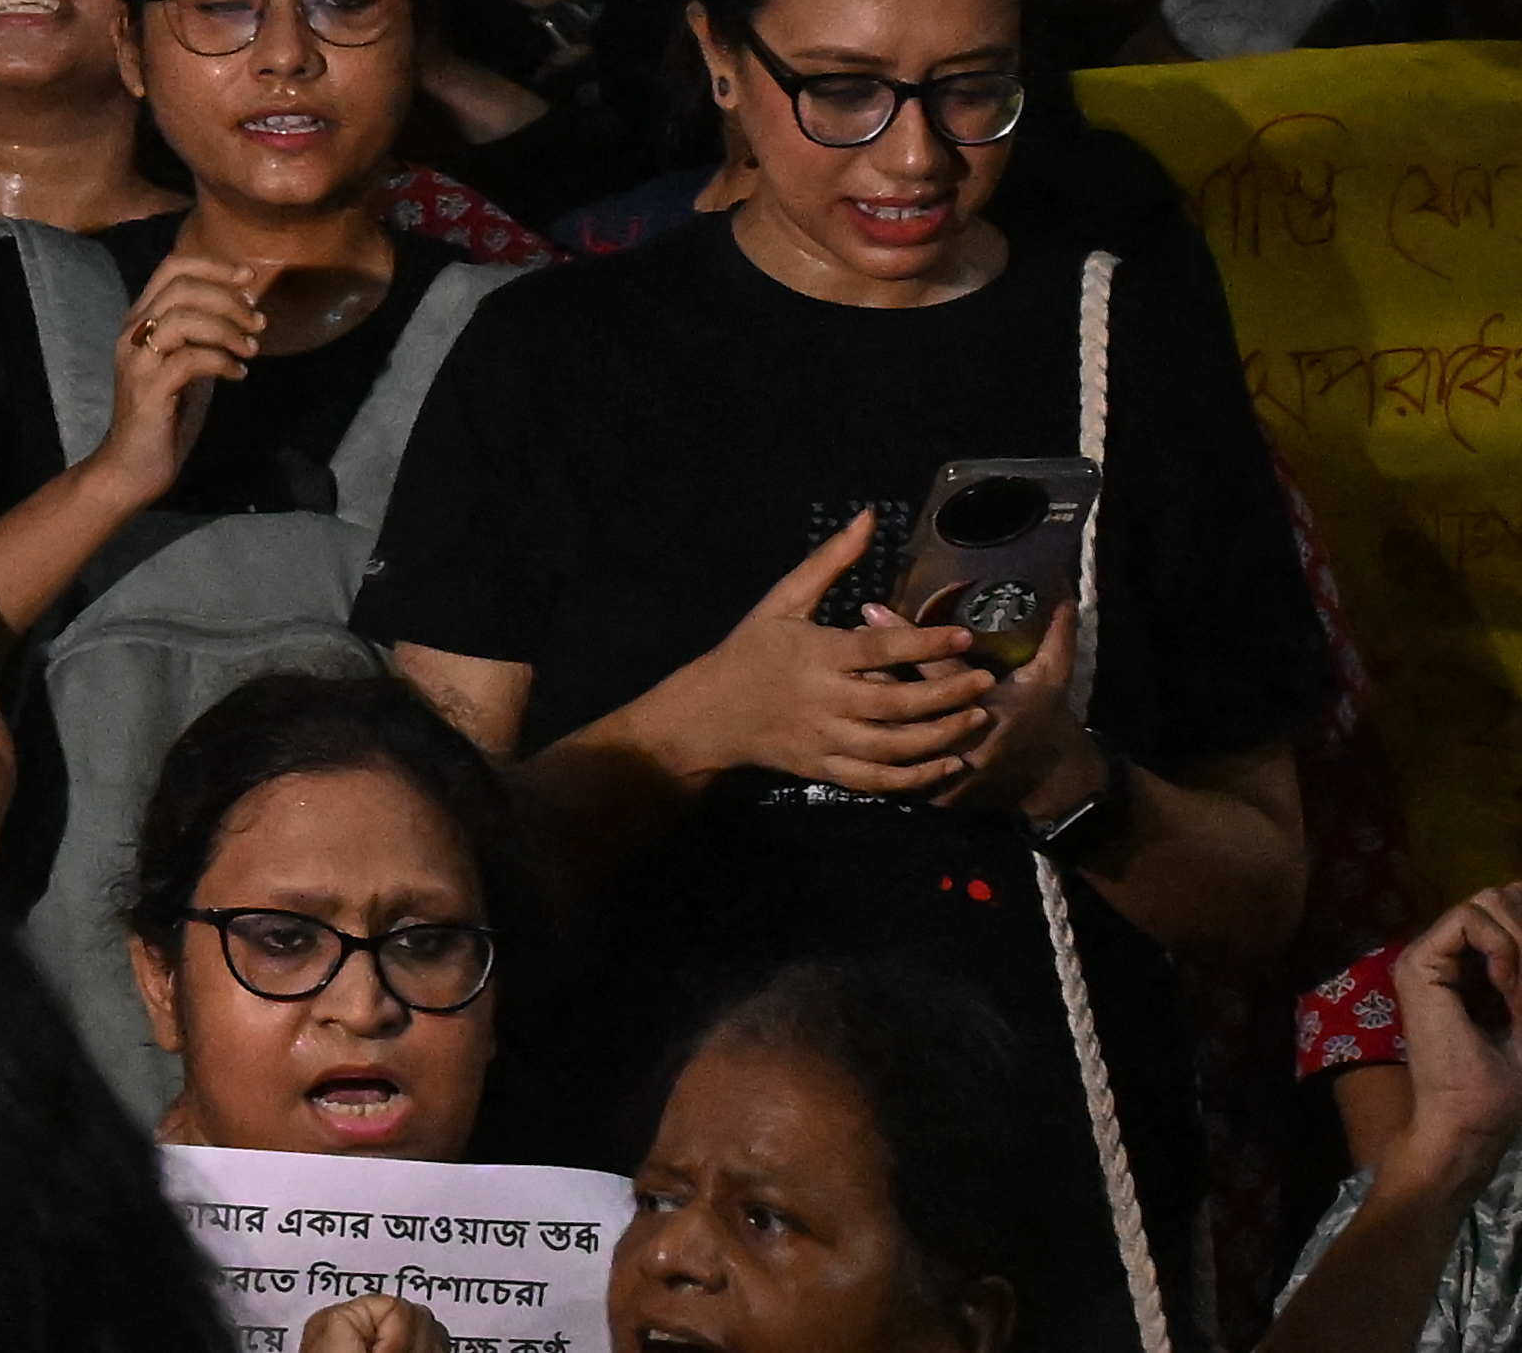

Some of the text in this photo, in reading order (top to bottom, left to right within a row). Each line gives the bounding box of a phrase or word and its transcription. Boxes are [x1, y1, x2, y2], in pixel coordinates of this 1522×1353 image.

[277, 1208, 374, 1240] একার
[382, 1213, 531, 1249] আওয়াজ
[394, 1264, 549, 1308] পিশাচেরা
